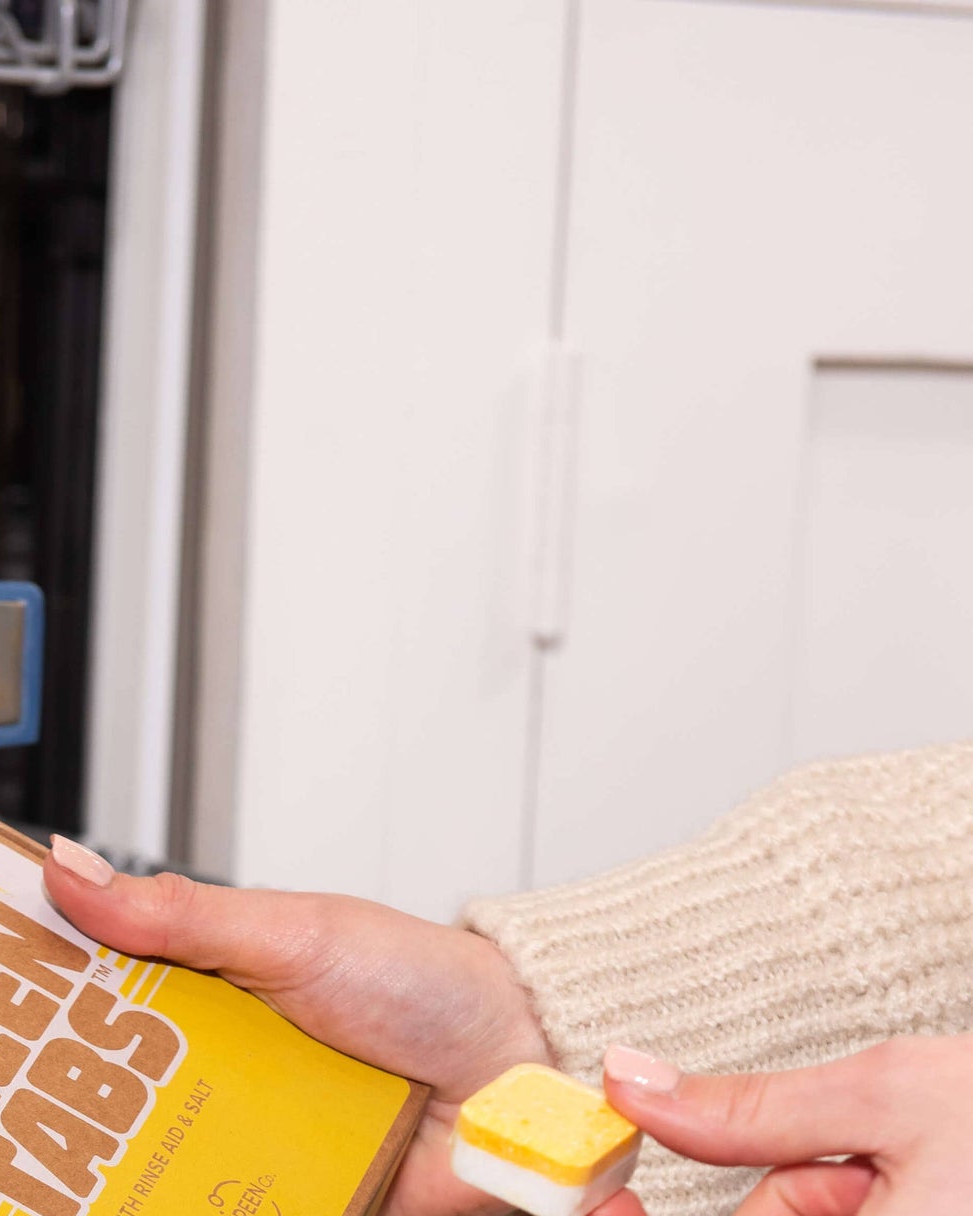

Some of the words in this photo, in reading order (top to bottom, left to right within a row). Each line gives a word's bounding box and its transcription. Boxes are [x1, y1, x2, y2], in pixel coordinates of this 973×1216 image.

[184, 1078, 214, 1114] SALT
[176, 1114, 194, 1127] &
[161, 1126, 185, 1155] AID
[132, 1152, 170, 1198] RINSE
